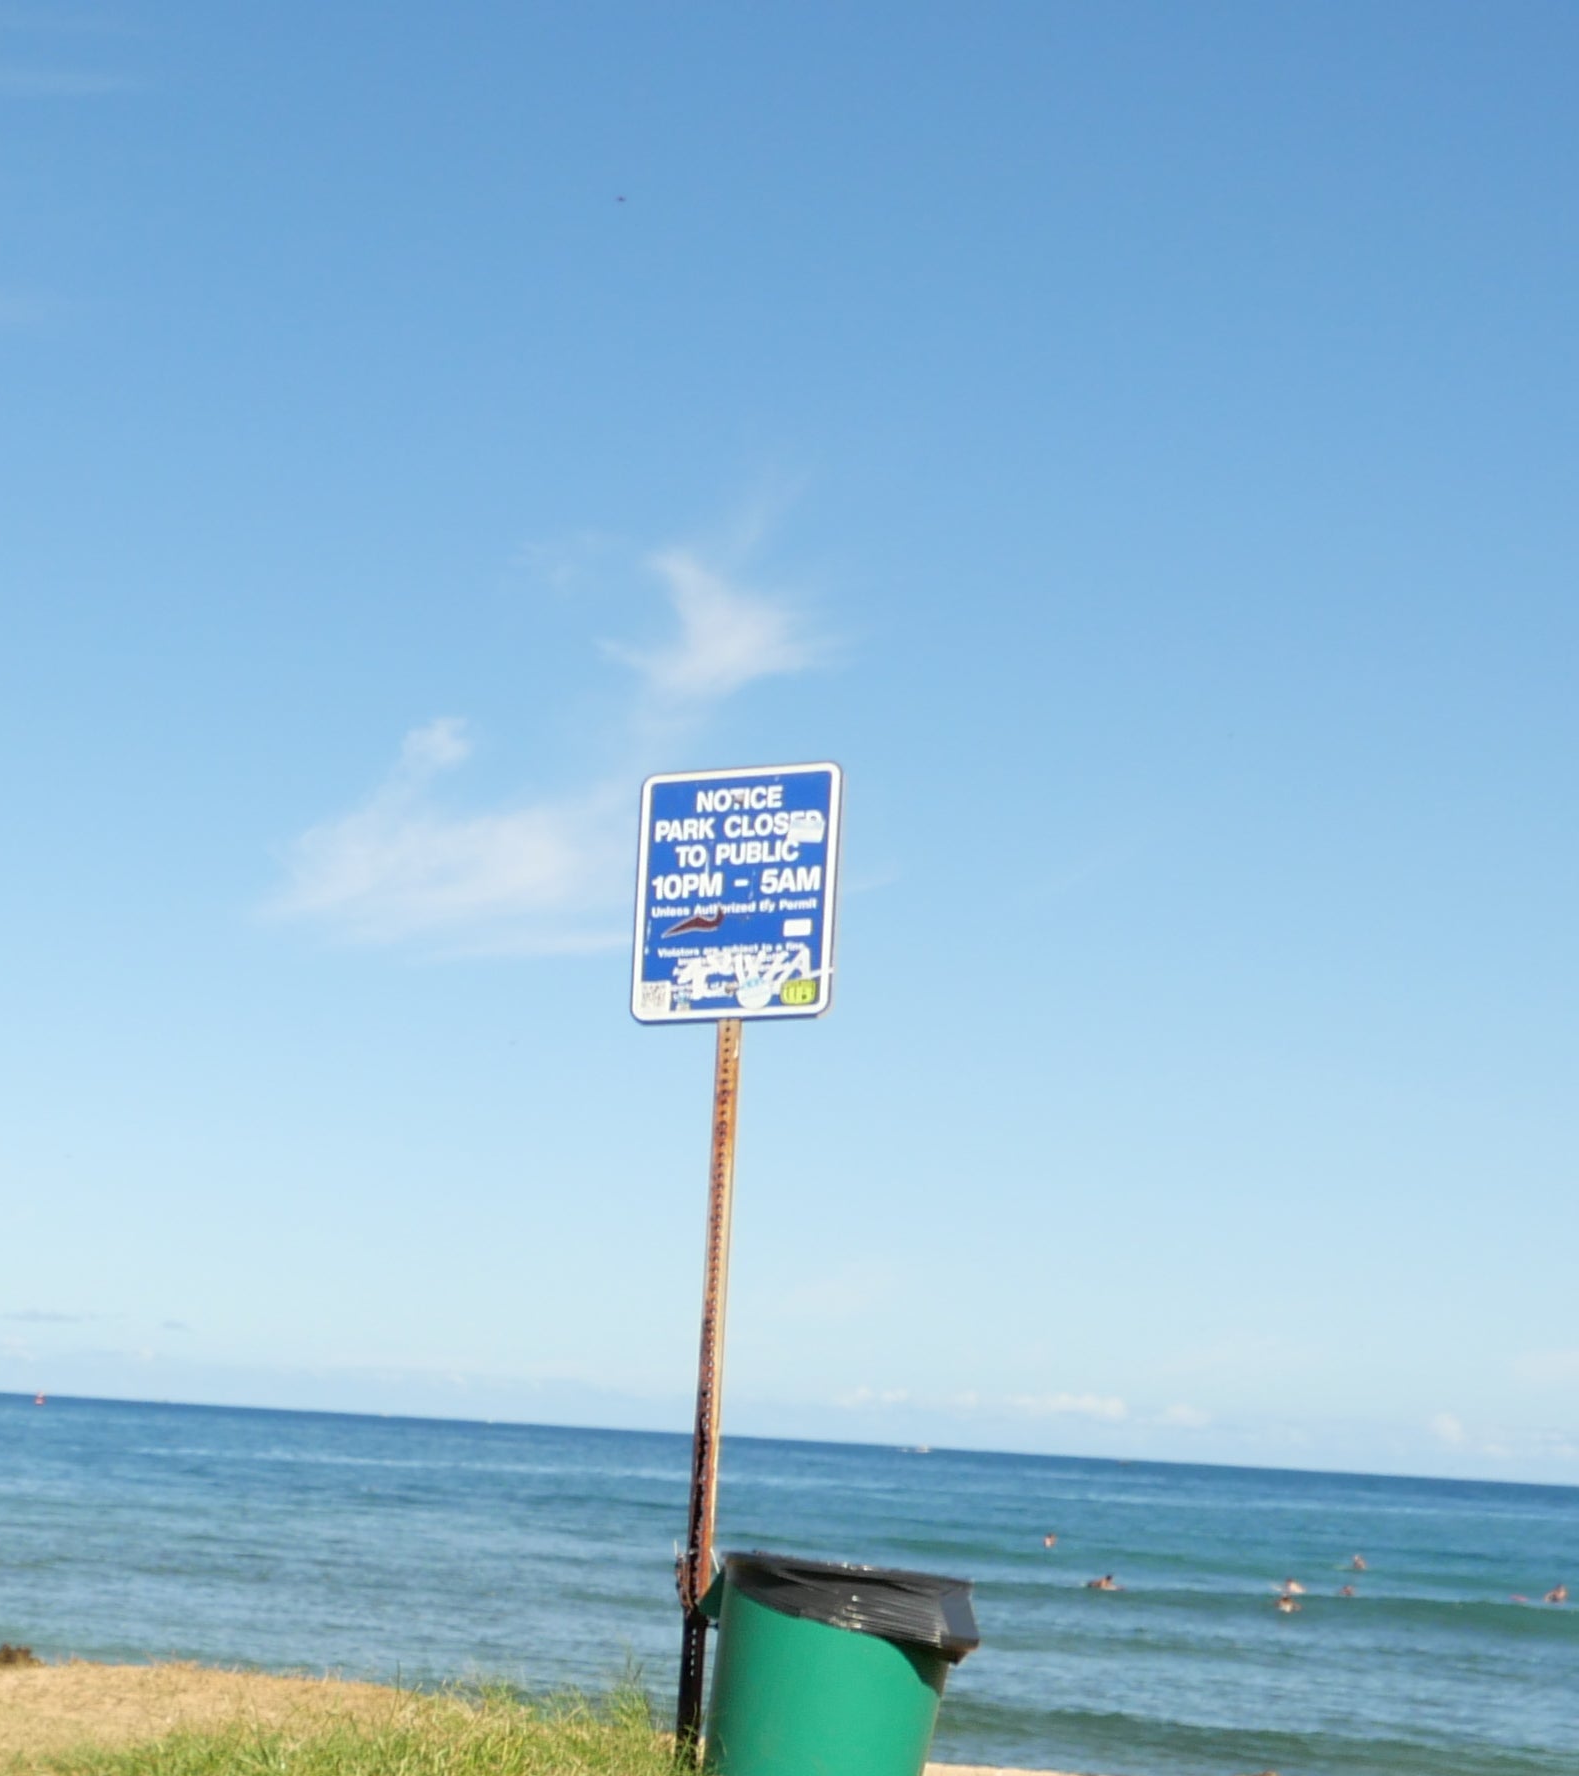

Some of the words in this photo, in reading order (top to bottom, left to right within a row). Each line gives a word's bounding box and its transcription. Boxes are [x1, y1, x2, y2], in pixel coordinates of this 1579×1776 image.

[696, 785, 783, 813] NOTICE
[655, 818, 715, 842] PARK
[675, 844, 707, 868] TO
[715, 841, 800, 866] PUBLIC
[652, 872, 723, 900] 10PM
[760, 866, 821, 894] 5AM
[651, 906, 690, 918] Unless
[779, 898, 817, 910] Permit
[657, 946, 699, 958] Violators
